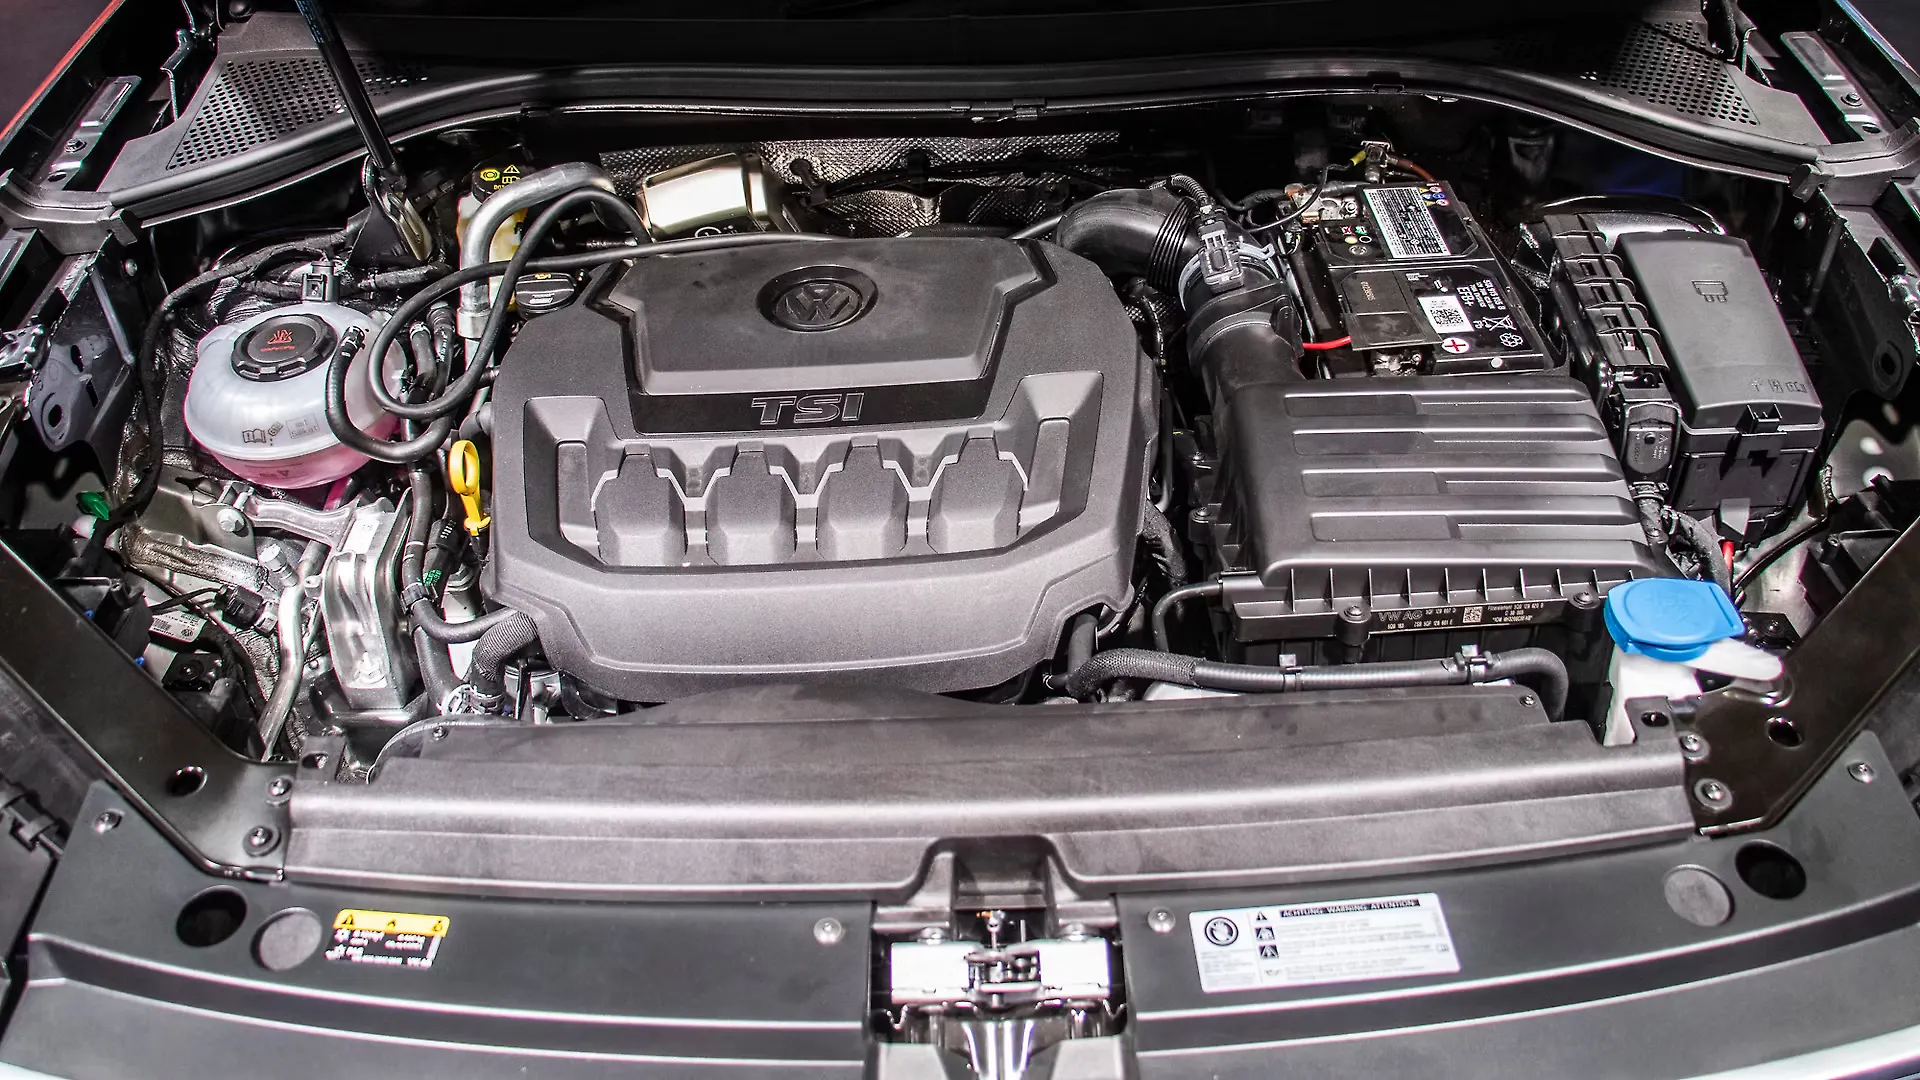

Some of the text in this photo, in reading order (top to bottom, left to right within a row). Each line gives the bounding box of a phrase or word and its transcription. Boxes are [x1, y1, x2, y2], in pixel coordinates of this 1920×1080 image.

[751, 392, 865, 426] TSI
[1378, 611, 1402, 621] VW
[1283, 900, 1415, 917] ACHTUNG WARNING ATTENTION
